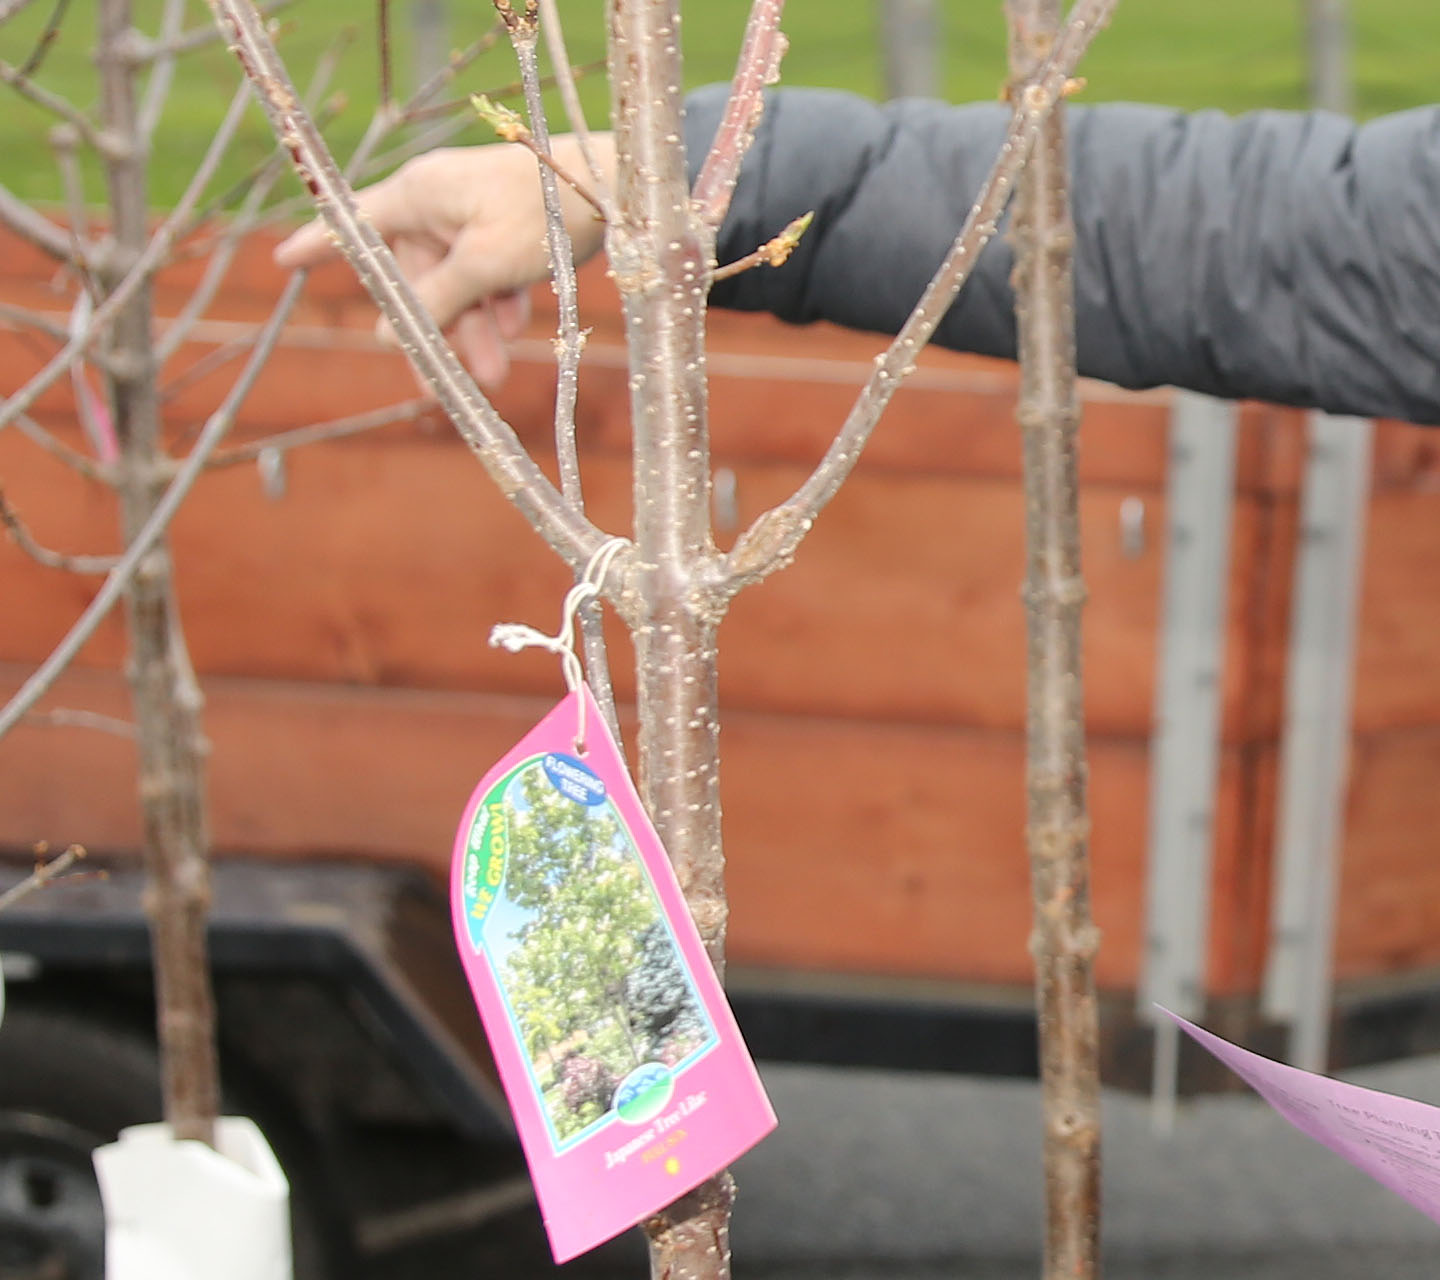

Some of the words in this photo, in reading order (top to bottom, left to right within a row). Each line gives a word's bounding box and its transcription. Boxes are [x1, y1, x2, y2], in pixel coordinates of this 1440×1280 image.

[560, 777, 589, 802] TREE
[653, 1110, 681, 1133] Tree
[1363, 1110, 1433, 1141] Planting
